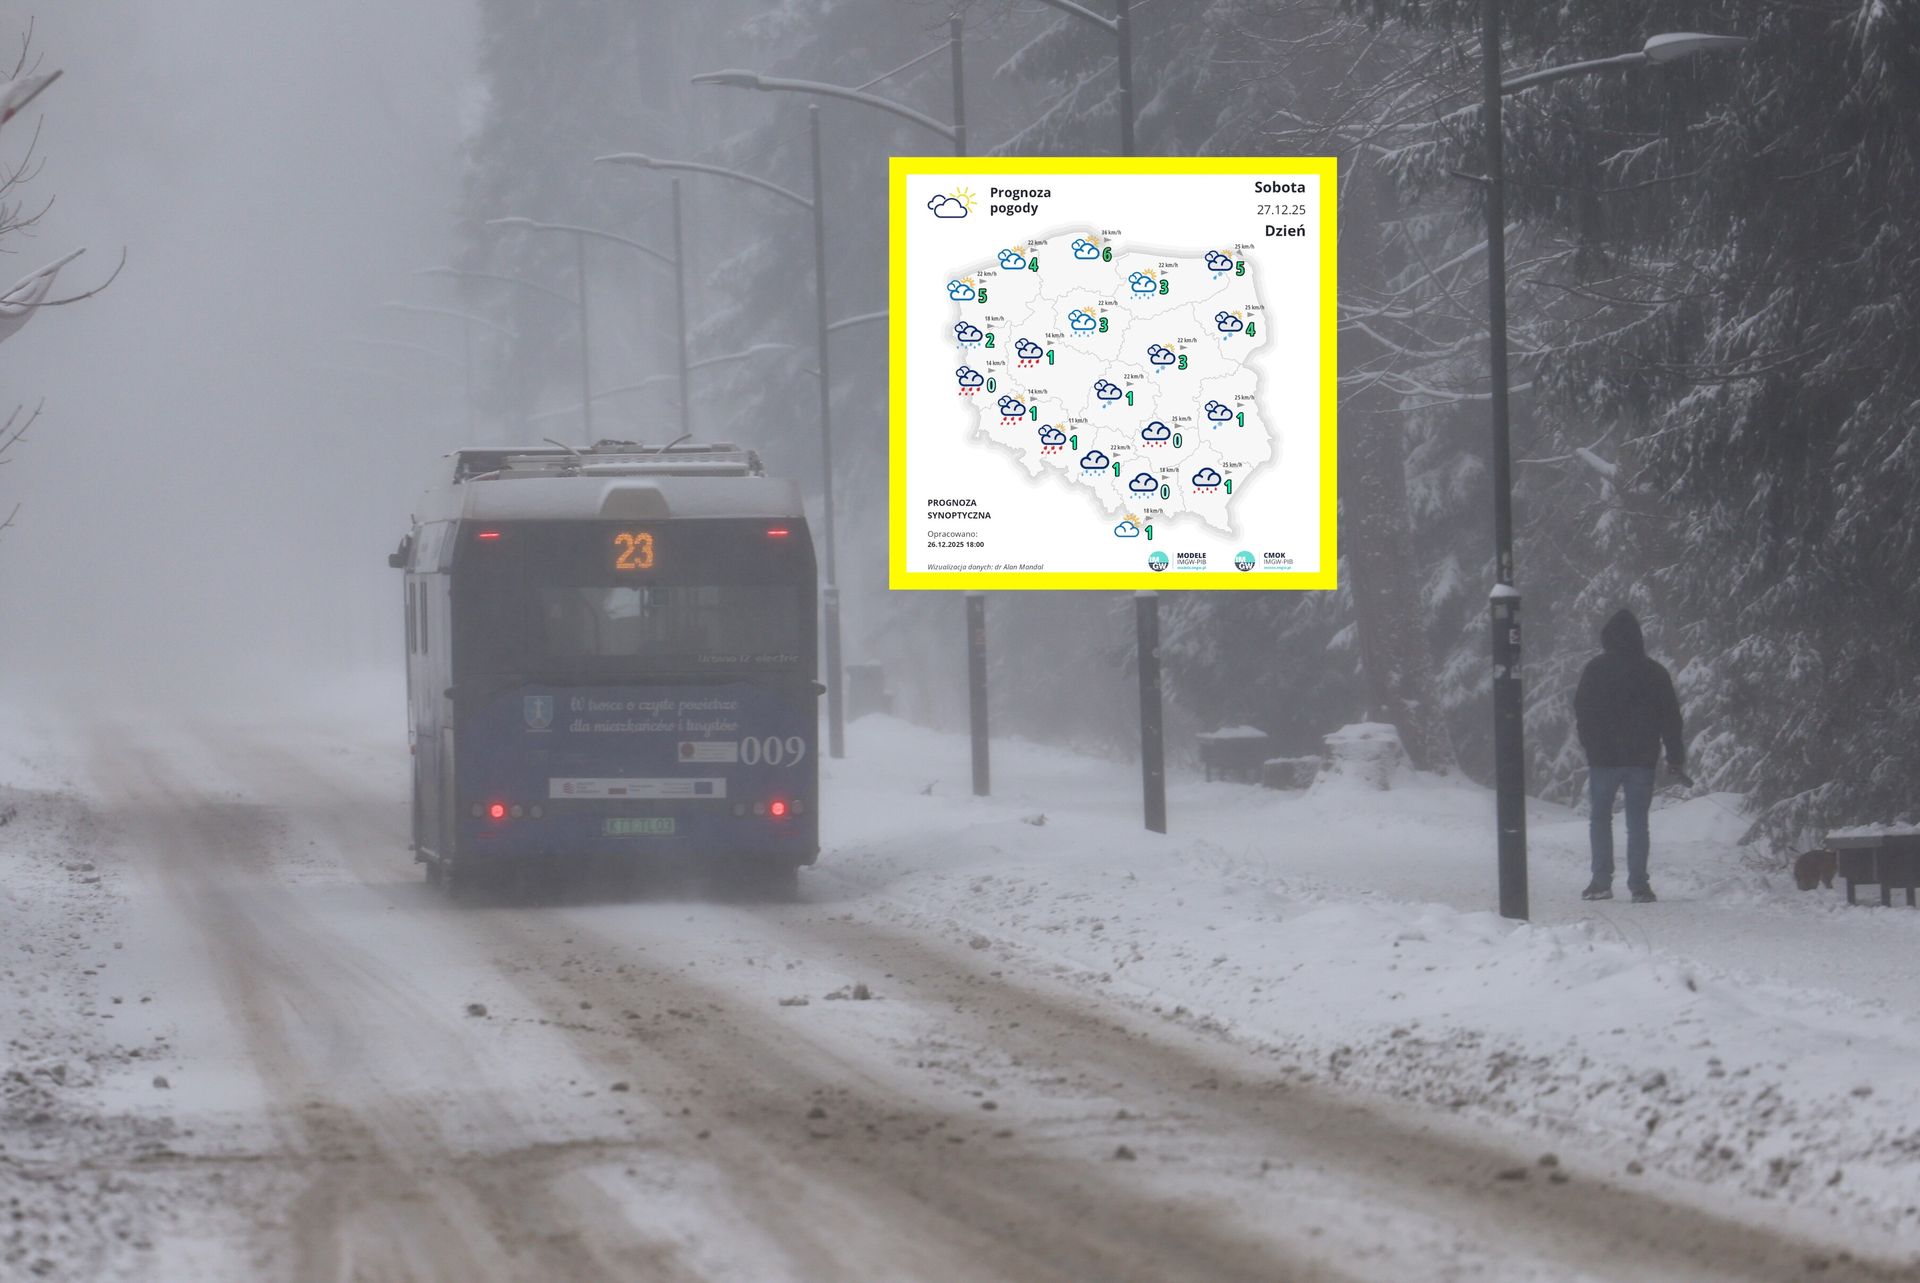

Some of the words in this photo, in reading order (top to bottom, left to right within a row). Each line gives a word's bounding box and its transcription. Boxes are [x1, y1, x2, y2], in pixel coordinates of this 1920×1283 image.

[614, 532, 655, 569] 23
[569, 719, 591, 732] dla
[740, 736, 806, 767] 009
